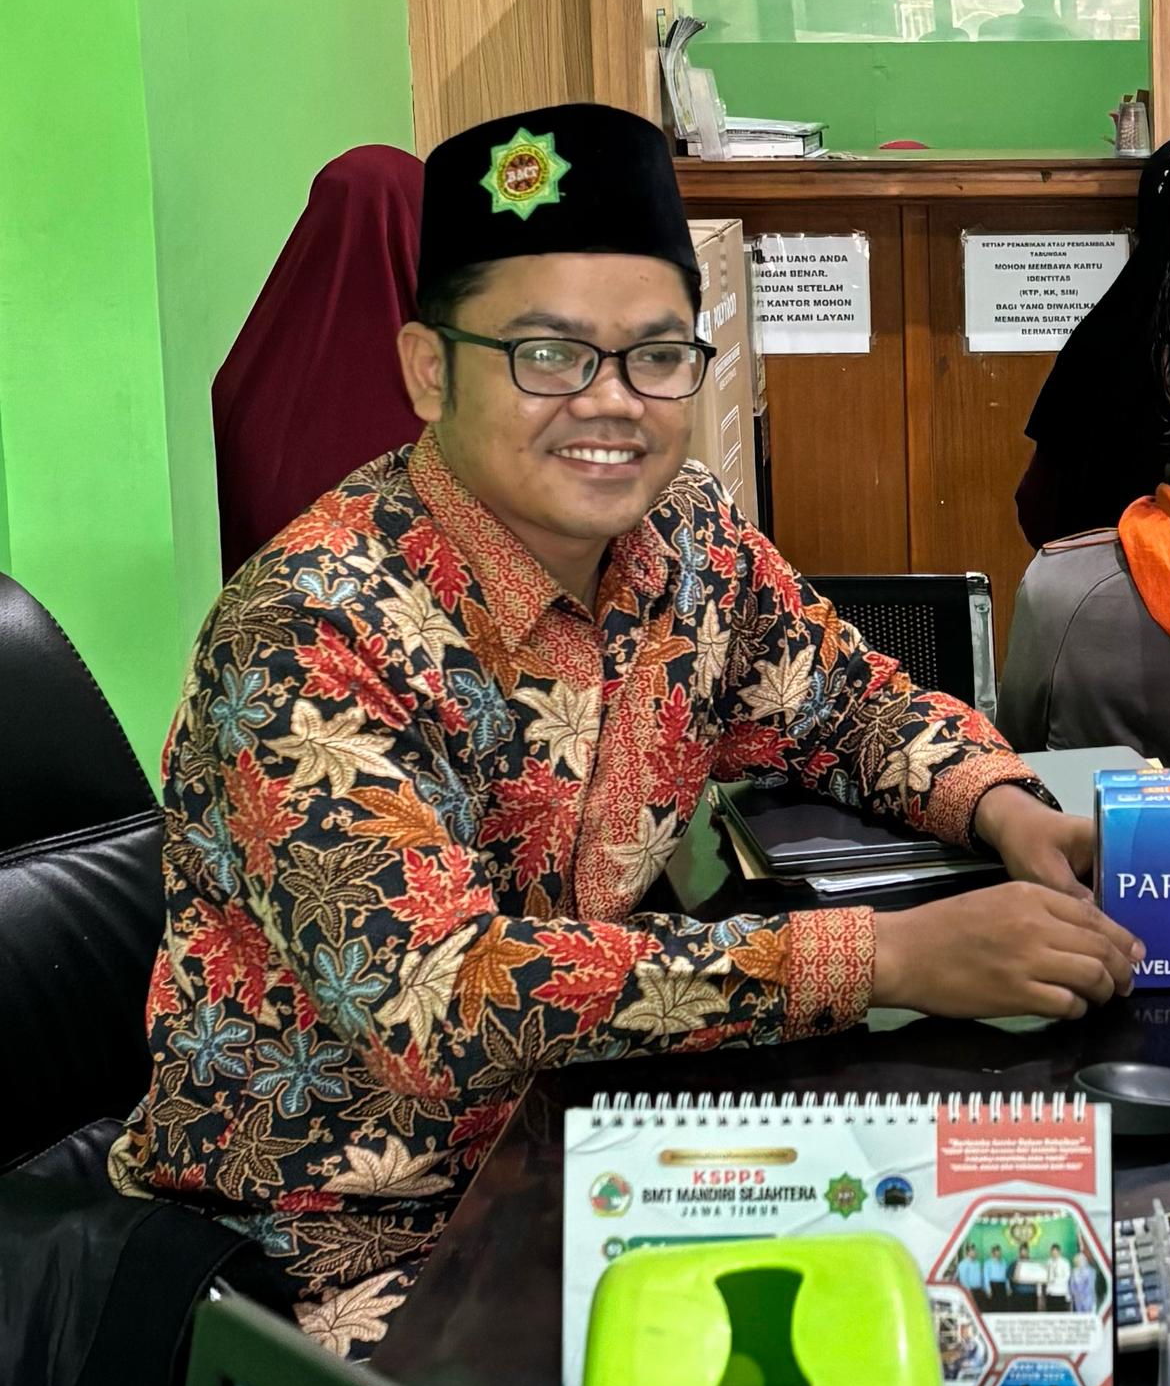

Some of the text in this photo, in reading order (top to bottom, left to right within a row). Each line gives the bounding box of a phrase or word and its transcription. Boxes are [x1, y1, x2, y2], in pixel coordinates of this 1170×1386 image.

[787, 255, 816, 263] UANG
[819, 255, 848, 263] ANDA
[797, 284, 843, 292] SETELAH
[767, 299, 810, 307] KANTOR
[813, 299, 852, 307] MOHON
[693, 1169, 766, 1185] KSPPS
[642, 1185, 817, 1203] BMT MANDIRI SEJAHTERA
[681, 1205, 779, 1217] JAWA TIMUR
